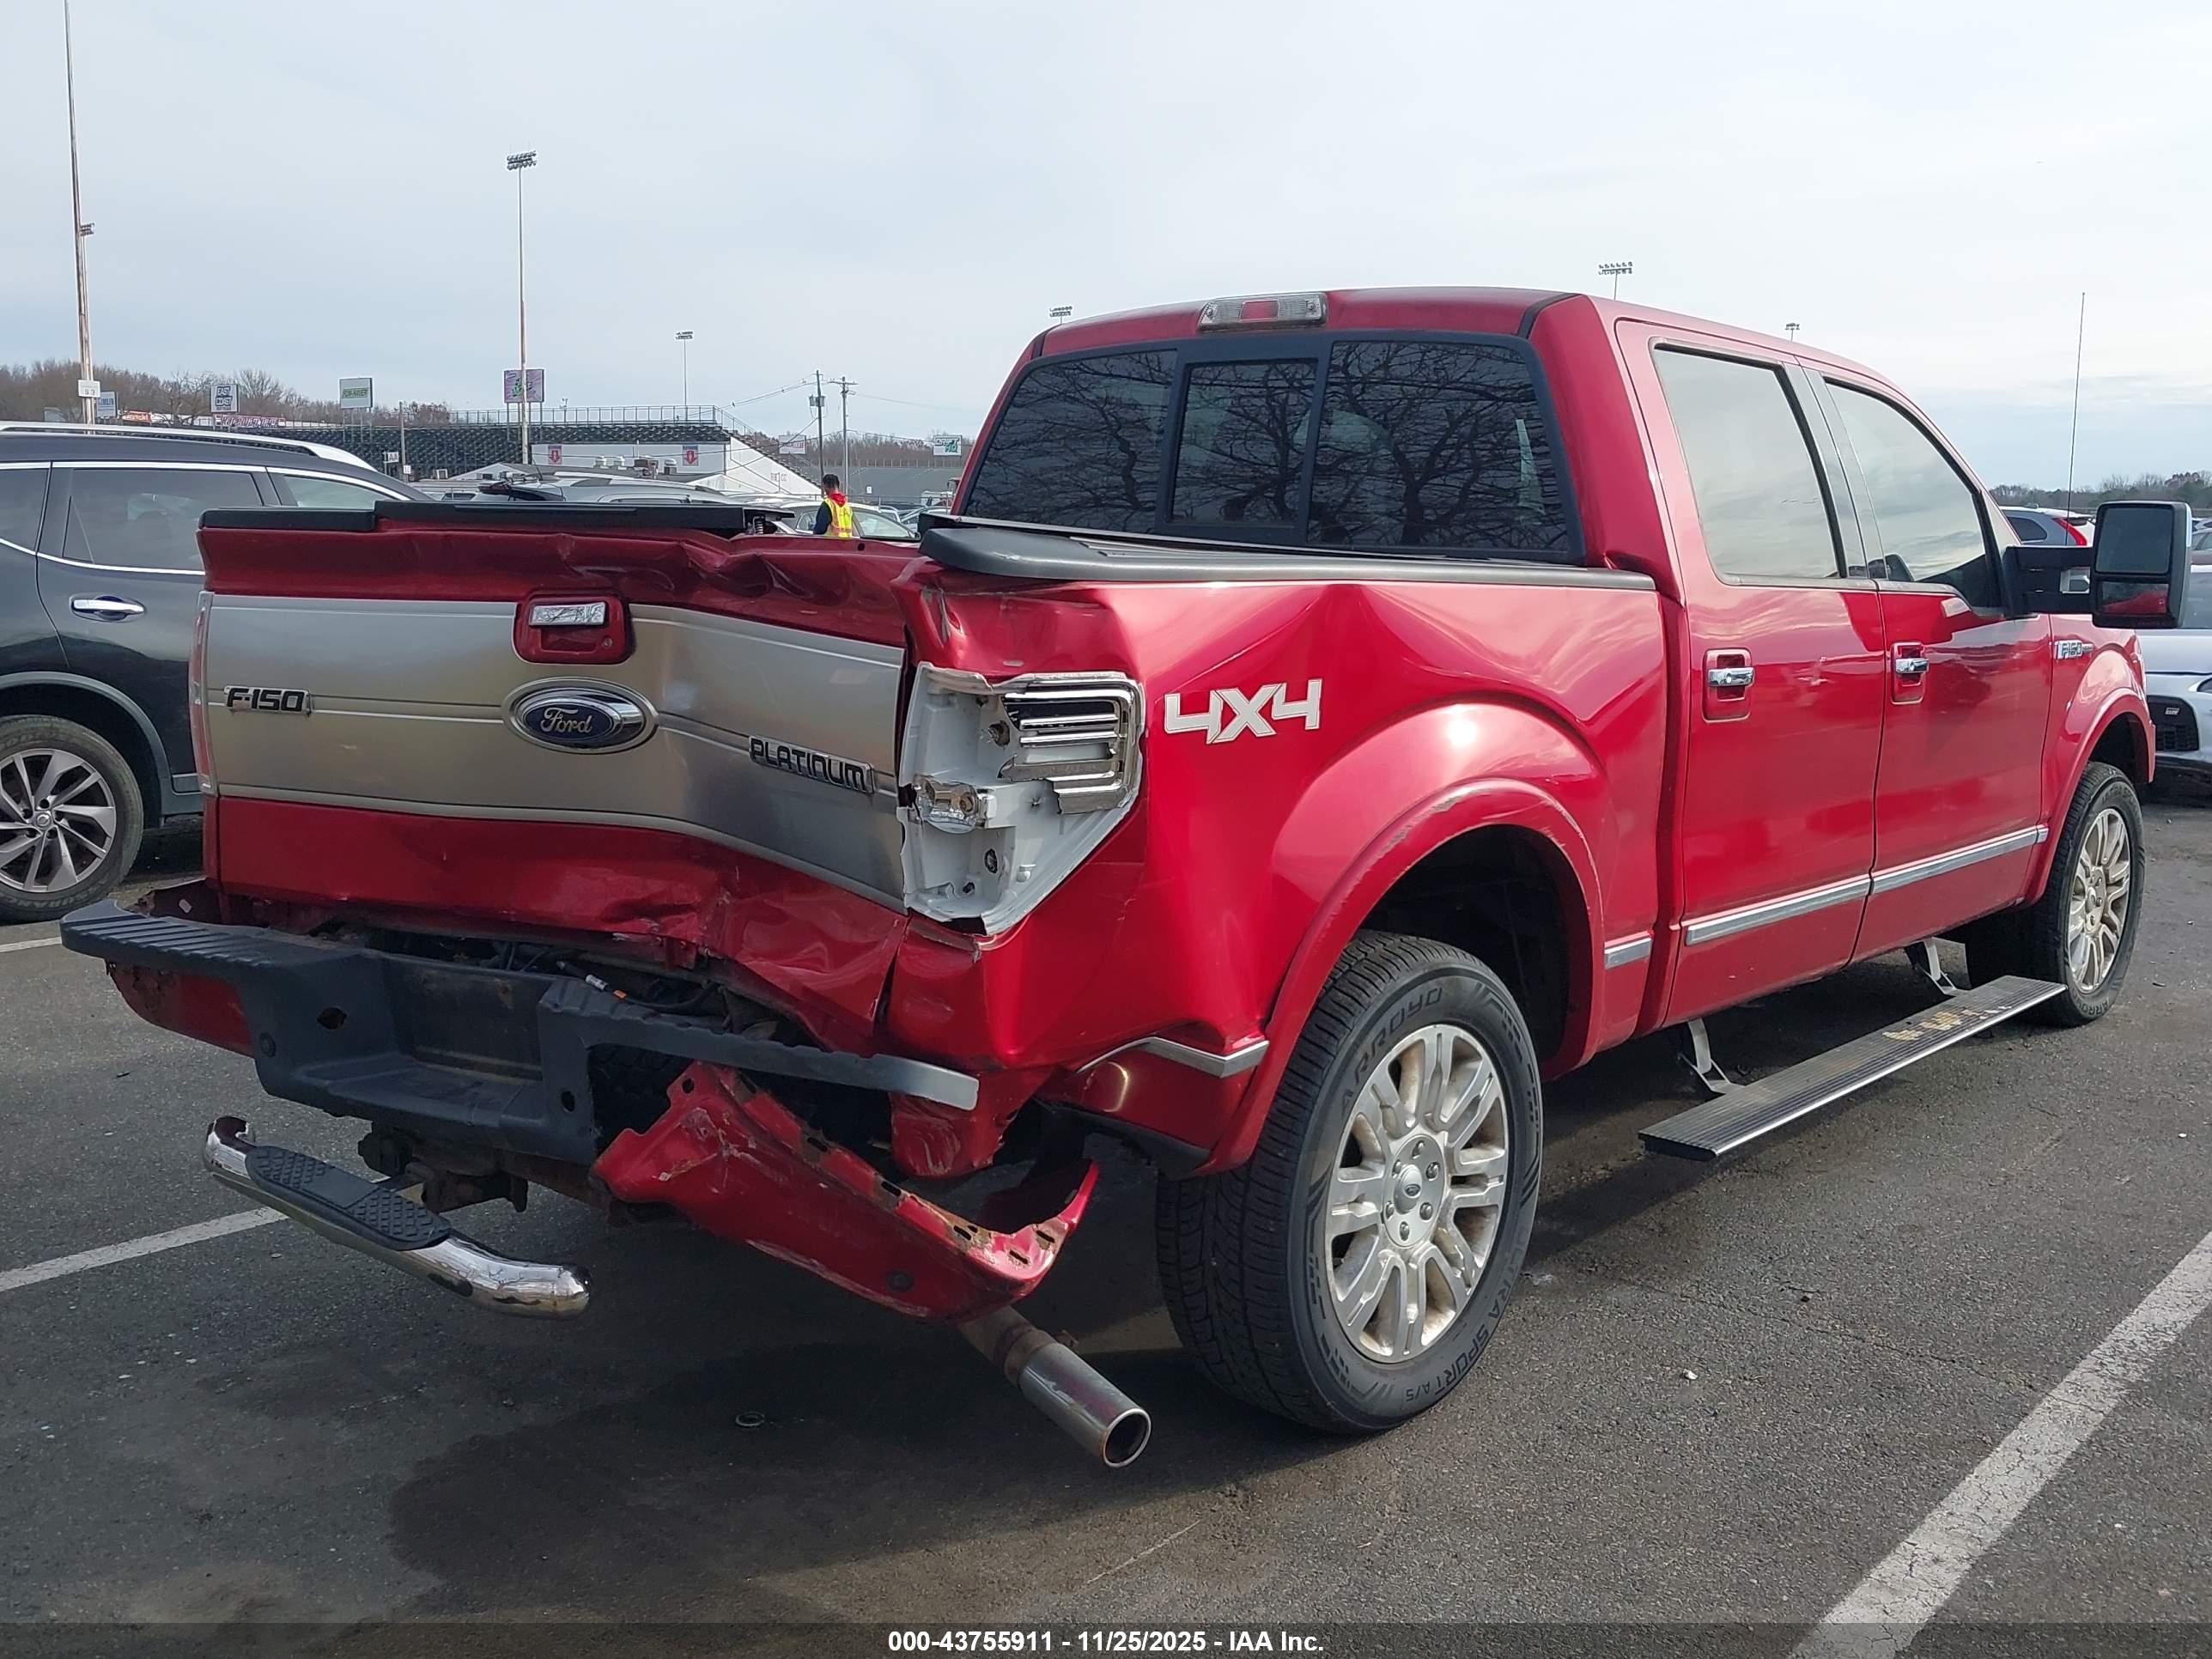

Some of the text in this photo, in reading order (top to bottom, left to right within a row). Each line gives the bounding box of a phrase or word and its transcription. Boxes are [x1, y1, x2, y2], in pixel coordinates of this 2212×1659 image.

[227, 688, 305, 712] F-150
[540, 707, 593, 733] Ford
[750, 738, 867, 792] PLATINUM
[1342, 988, 1443, 1119] ARROYO
[1435, 1323, 1491, 1395] SPORT
[1406, 1380, 1431, 1402] A/S
